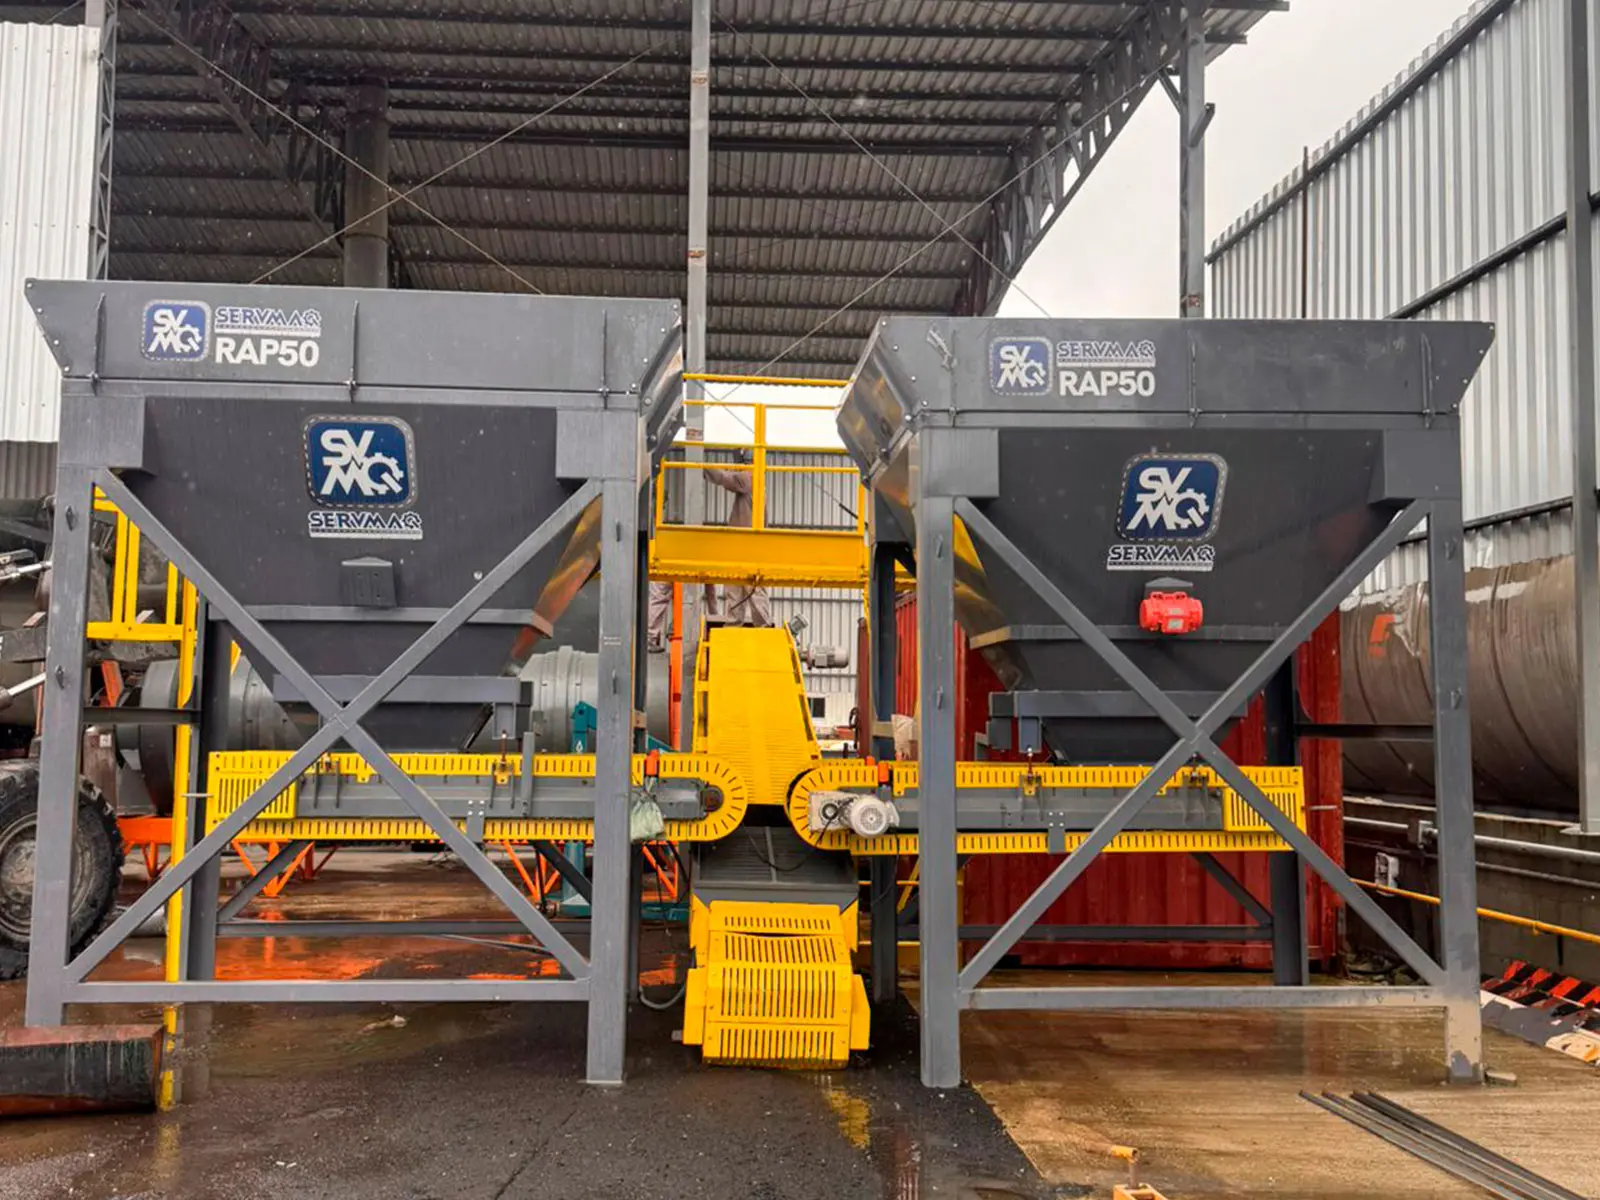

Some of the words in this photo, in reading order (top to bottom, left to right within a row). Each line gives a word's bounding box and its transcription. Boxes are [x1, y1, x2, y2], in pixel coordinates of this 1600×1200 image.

[215, 306, 322, 328] SERVMAQ
[215, 337, 320, 368] RAP50
[1056, 340, 1156, 359] SERVMAQ
[1059, 371, 1156, 397] RAP50
[308, 510, 422, 530] SERVMAQ
[1108, 545, 1216, 562] SERVMAQ
